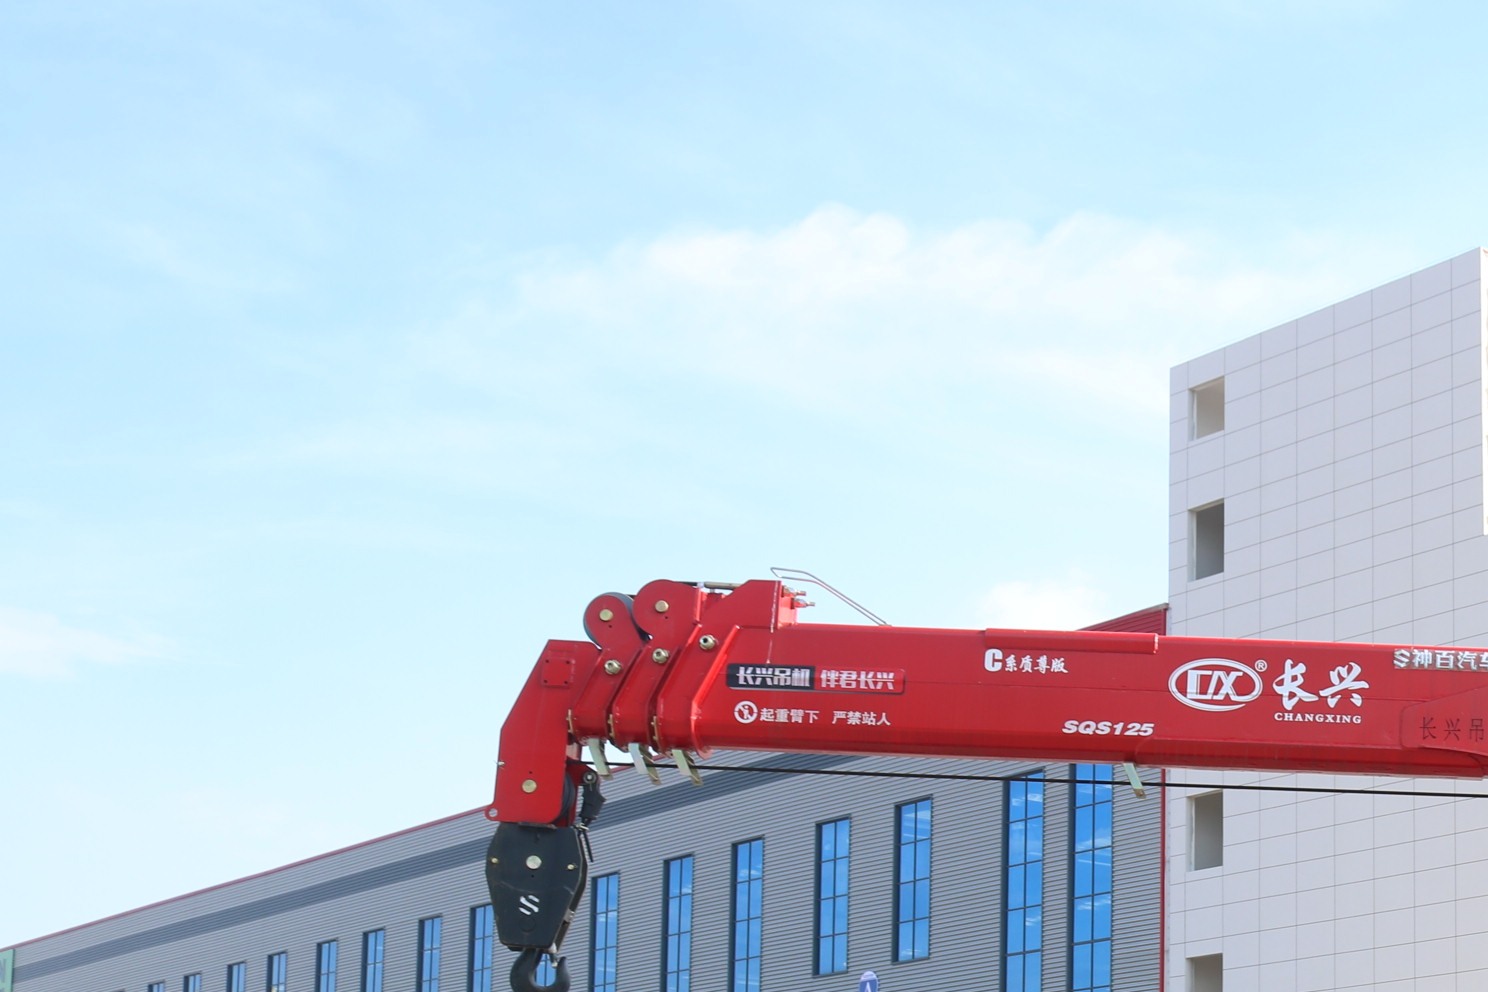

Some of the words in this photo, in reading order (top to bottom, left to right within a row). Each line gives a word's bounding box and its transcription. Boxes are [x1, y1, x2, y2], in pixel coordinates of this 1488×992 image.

[736, 666, 811, 688] 长兴吊机
[820, 669, 895, 690] 伴君长兴
[1272, 659, 1370, 711] 长兴
[759, 707, 820, 724] 起重臂下
[832, 710, 891, 726] 严禁站人
[1274, 712, 1362, 724] CHANGXING
[1062, 720, 1154, 736] SQS125
